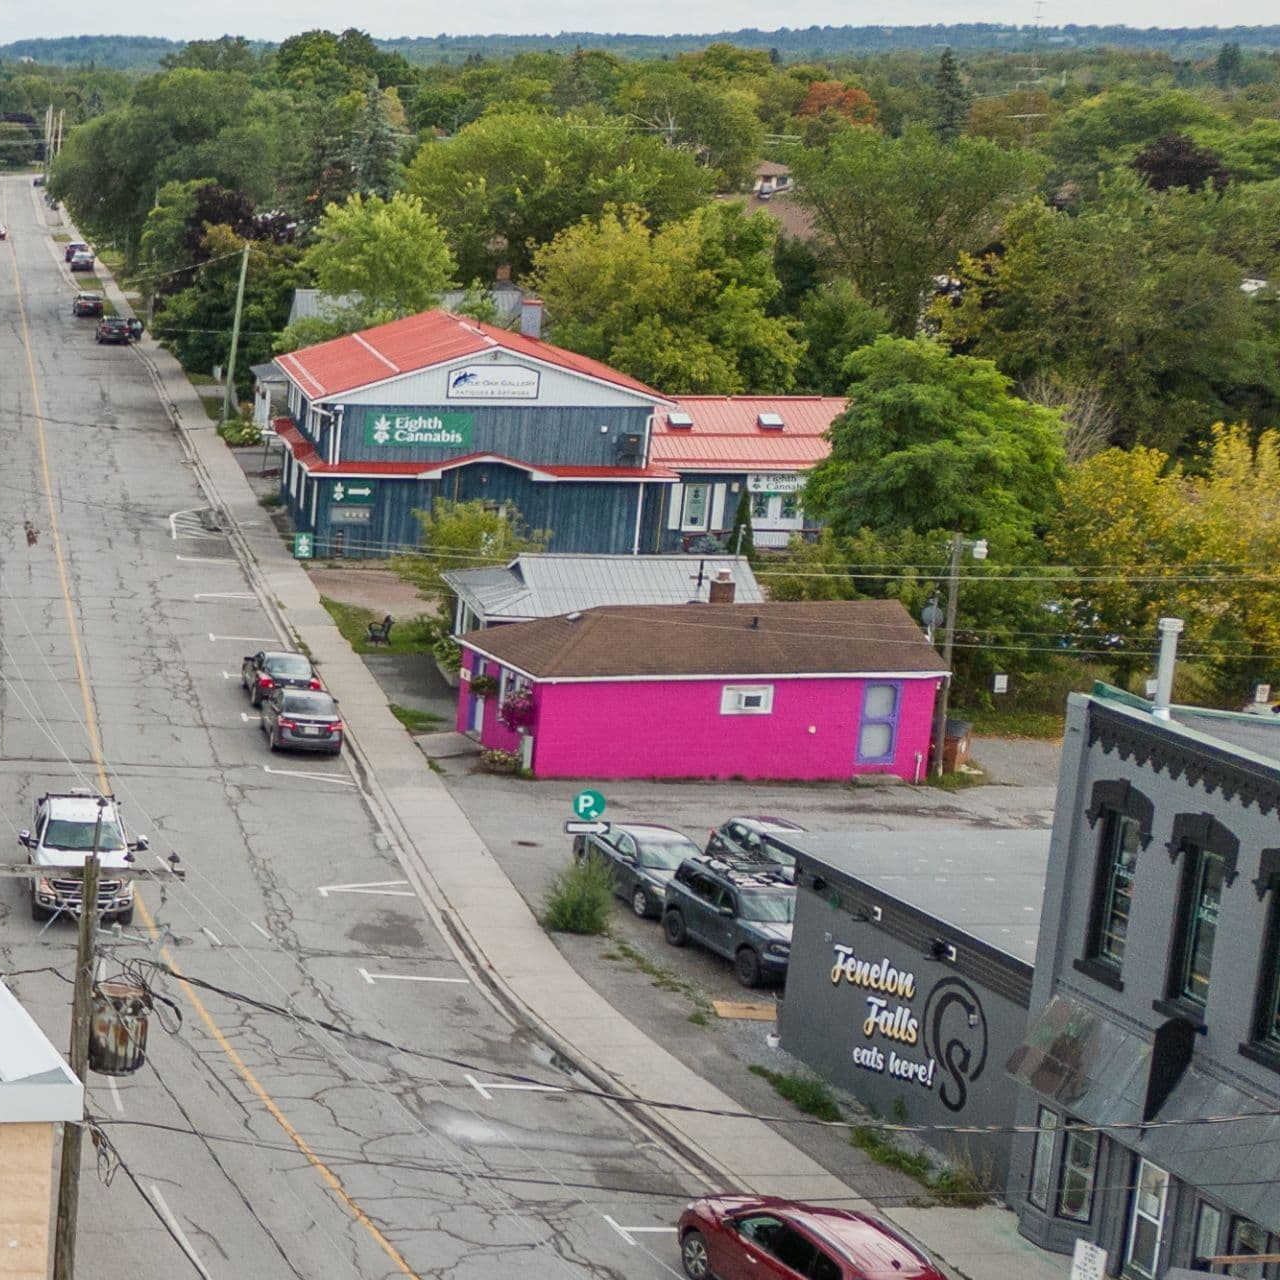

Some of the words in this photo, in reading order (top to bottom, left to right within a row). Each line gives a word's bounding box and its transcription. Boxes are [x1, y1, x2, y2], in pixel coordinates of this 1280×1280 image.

[394, 416, 443, 432] Eighth
[394, 430, 463, 443] Cannabis
[578, 795, 594, 813] P
[831, 944, 917, 1000] Fenelon
[863, 996, 920, 1045] Falls
[853, 1046, 885, 1072] eats
[889, 1051, 936, 1087] here!
